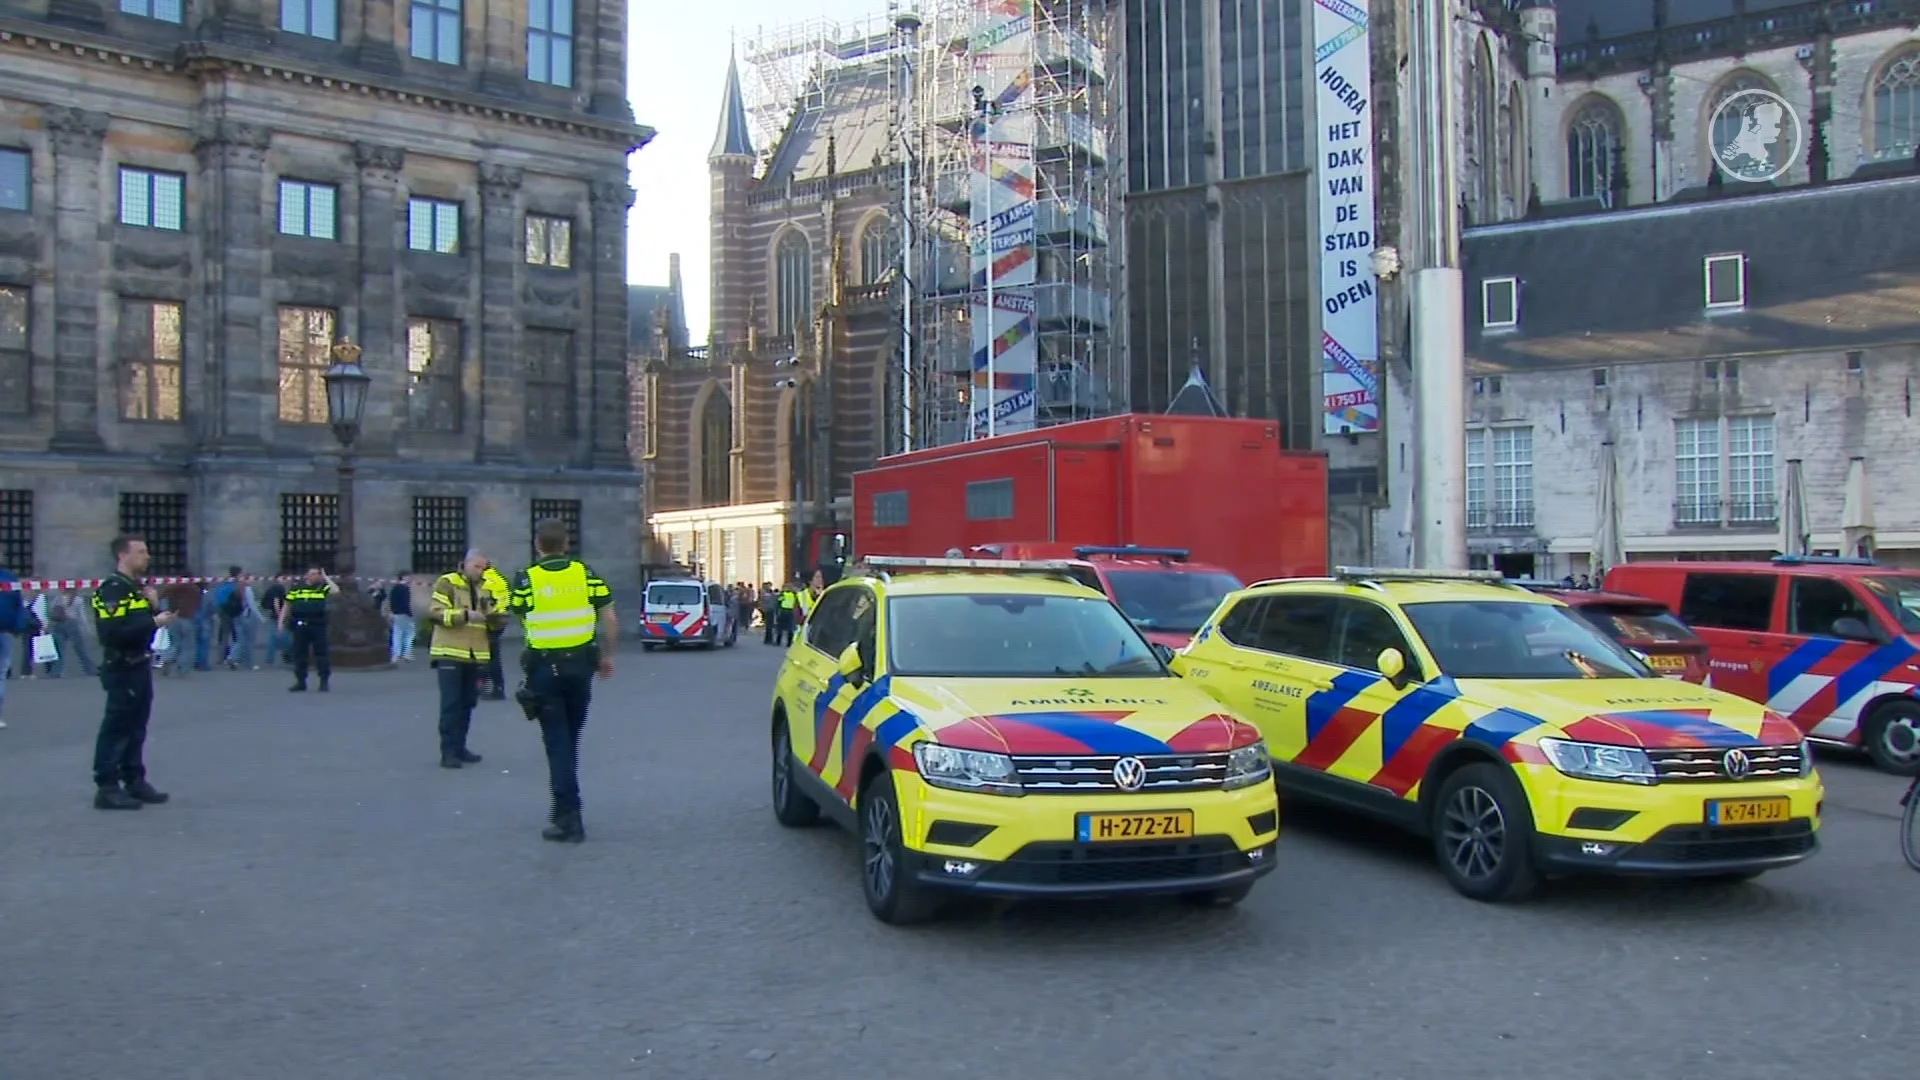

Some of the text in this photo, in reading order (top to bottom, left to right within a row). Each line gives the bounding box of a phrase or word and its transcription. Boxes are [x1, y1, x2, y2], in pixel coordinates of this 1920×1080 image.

[1320, 66, 1367, 115] HOERA
[1329, 121, 1361, 141] HET
[1328, 148, 1363, 168] DAK
[1328, 176, 1364, 196] VAN
[1336, 204, 1359, 222] DE
[1325, 231, 1370, 251] STAD
[1340, 260, 1357, 277] IS
[1325, 280, 1372, 314] OPEN
[1250, 679, 1303, 698] AMBULANCE
[1011, 697, 1168, 706] AMBULANCE
[1725, 803, 1781, 821] K-741-JJ
[1100, 816, 1185, 837] H-272-ZL
